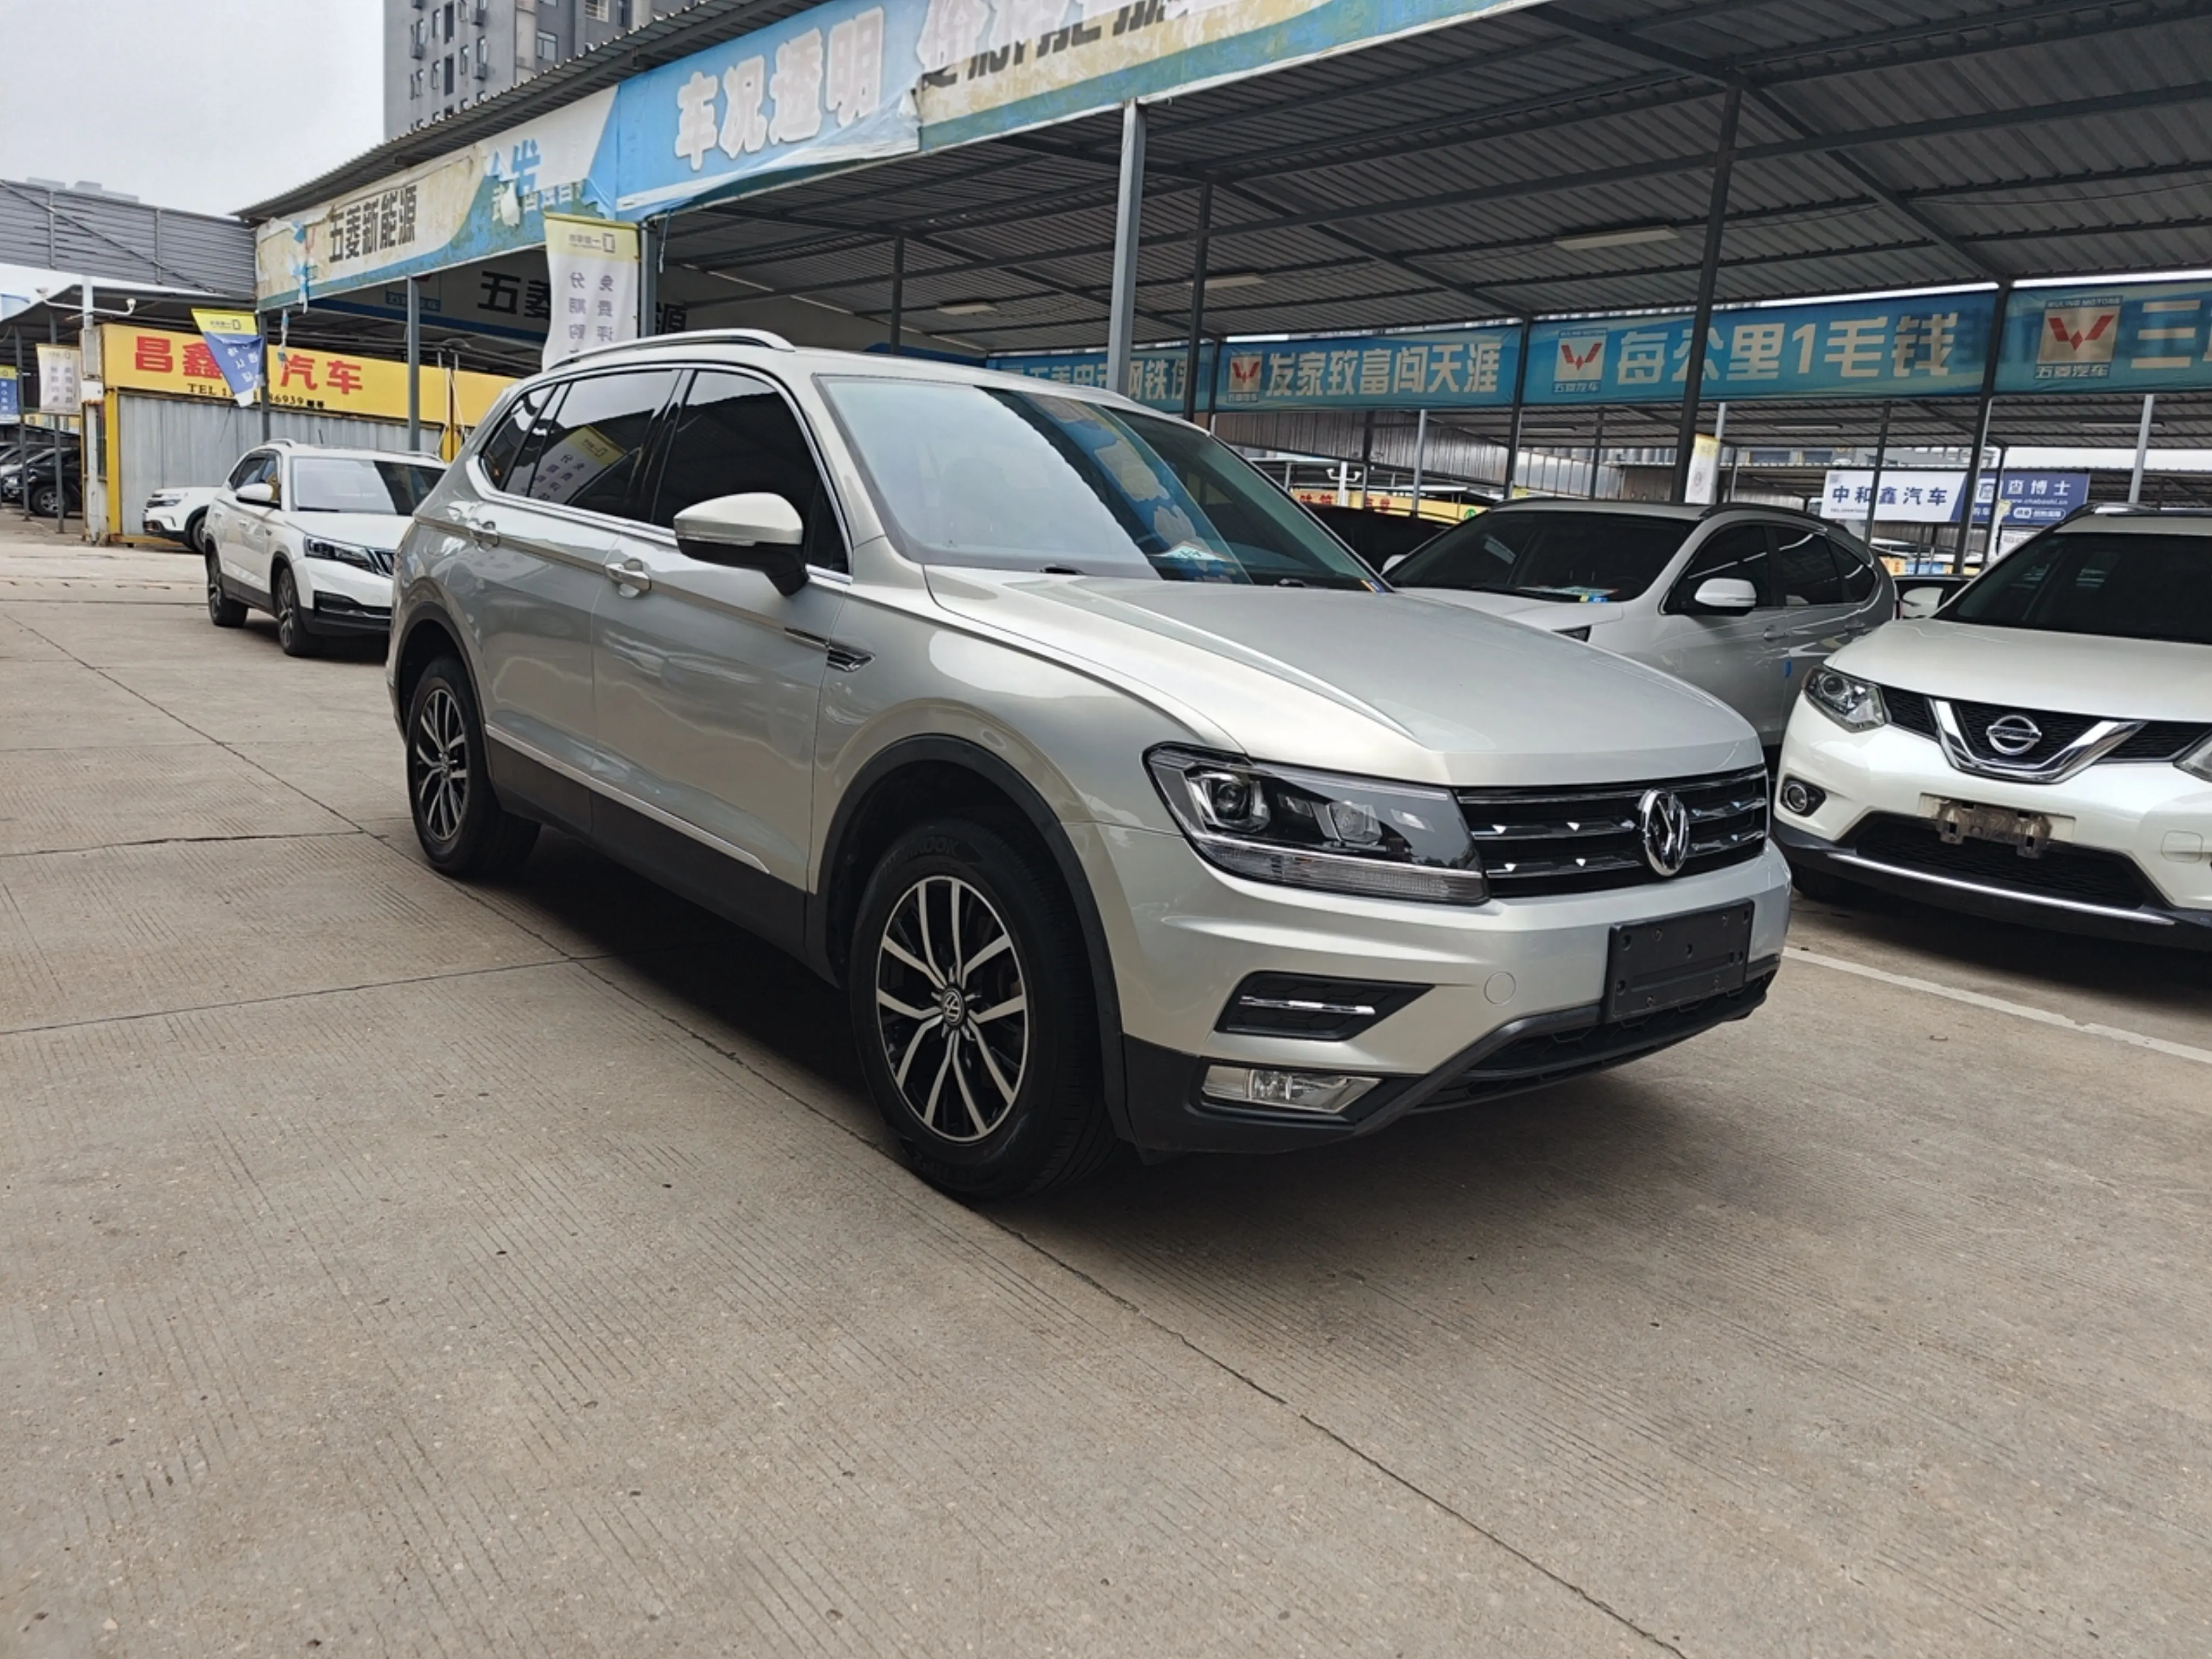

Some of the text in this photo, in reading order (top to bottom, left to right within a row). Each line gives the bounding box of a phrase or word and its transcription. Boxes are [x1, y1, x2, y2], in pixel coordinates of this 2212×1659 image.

[675, 6, 884, 173] 车况透明
[328, 184, 417, 264] 五菱新能源
[1266, 343, 1502, 397] 发家致富闯天涯
[1617, 312, 1959, 386] 每公里1毛钱
[187, 383, 217, 395] TEL
[2007, 479, 2071, 496] 查博士
